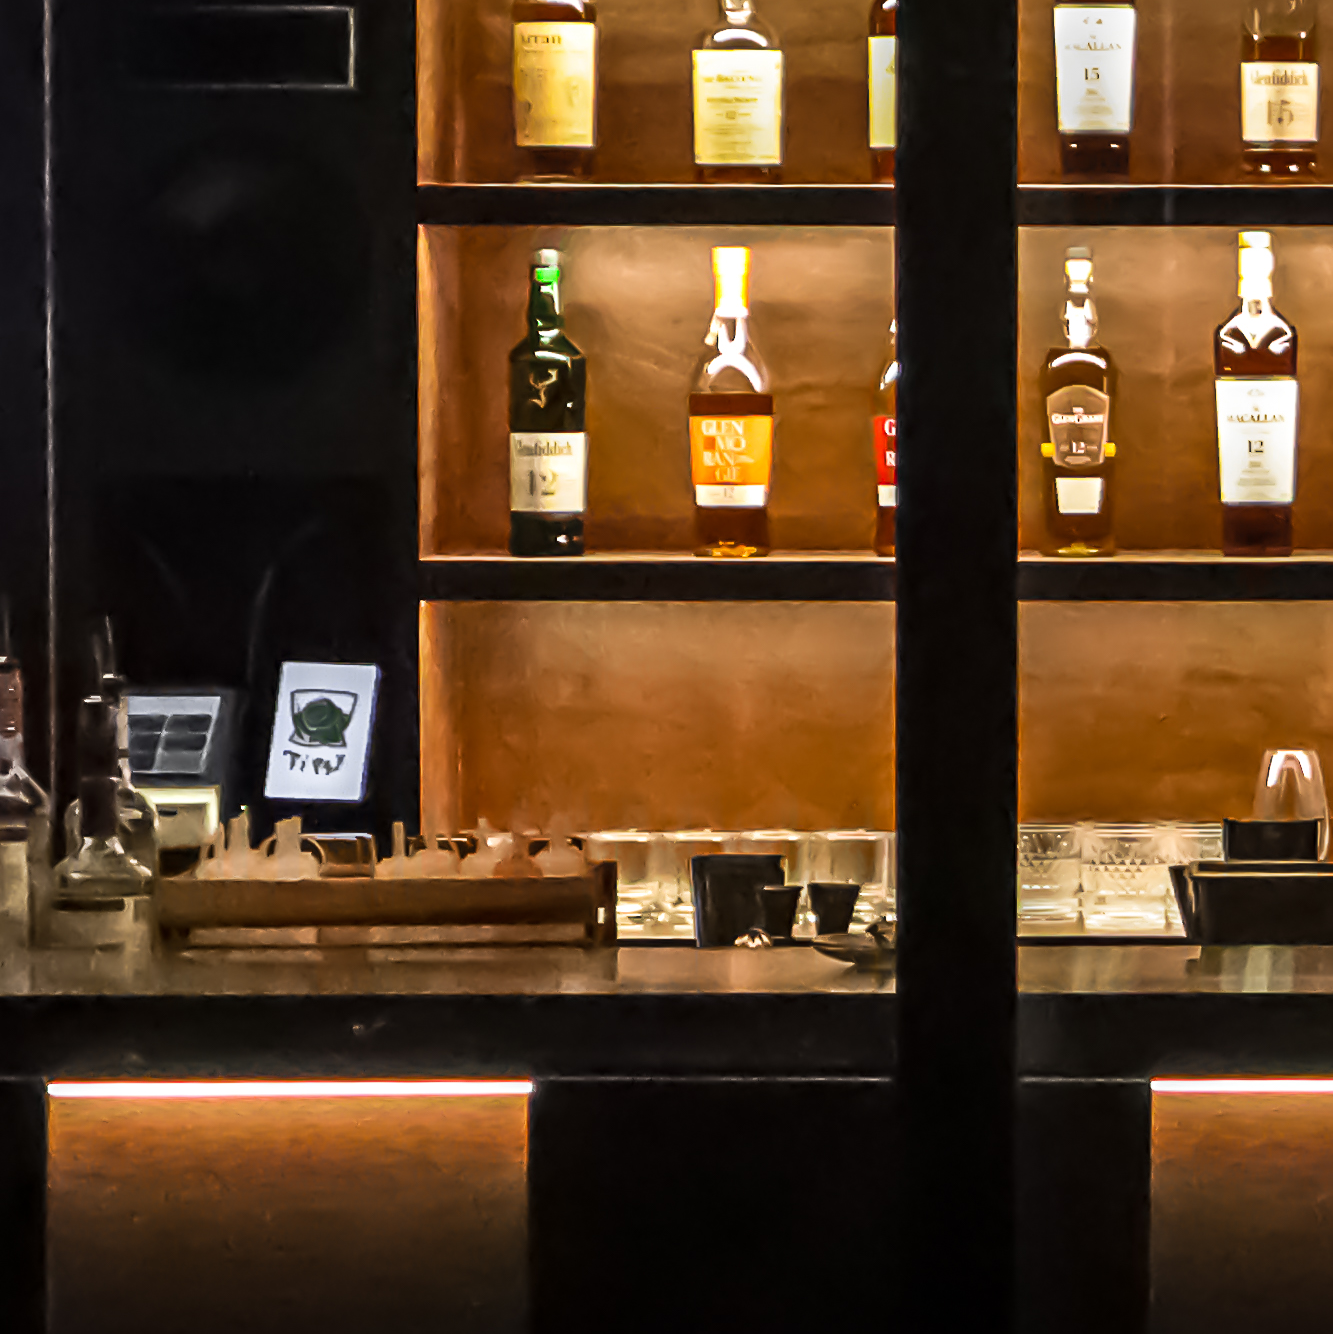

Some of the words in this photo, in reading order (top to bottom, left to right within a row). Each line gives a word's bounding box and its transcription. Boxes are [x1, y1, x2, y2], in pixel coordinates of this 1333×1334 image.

[1084, 67, 1100, 81] 15
[1266, 99, 1294, 127] 15
[1248, 440, 1264, 454] 12
[527, 470, 557, 496] 12
